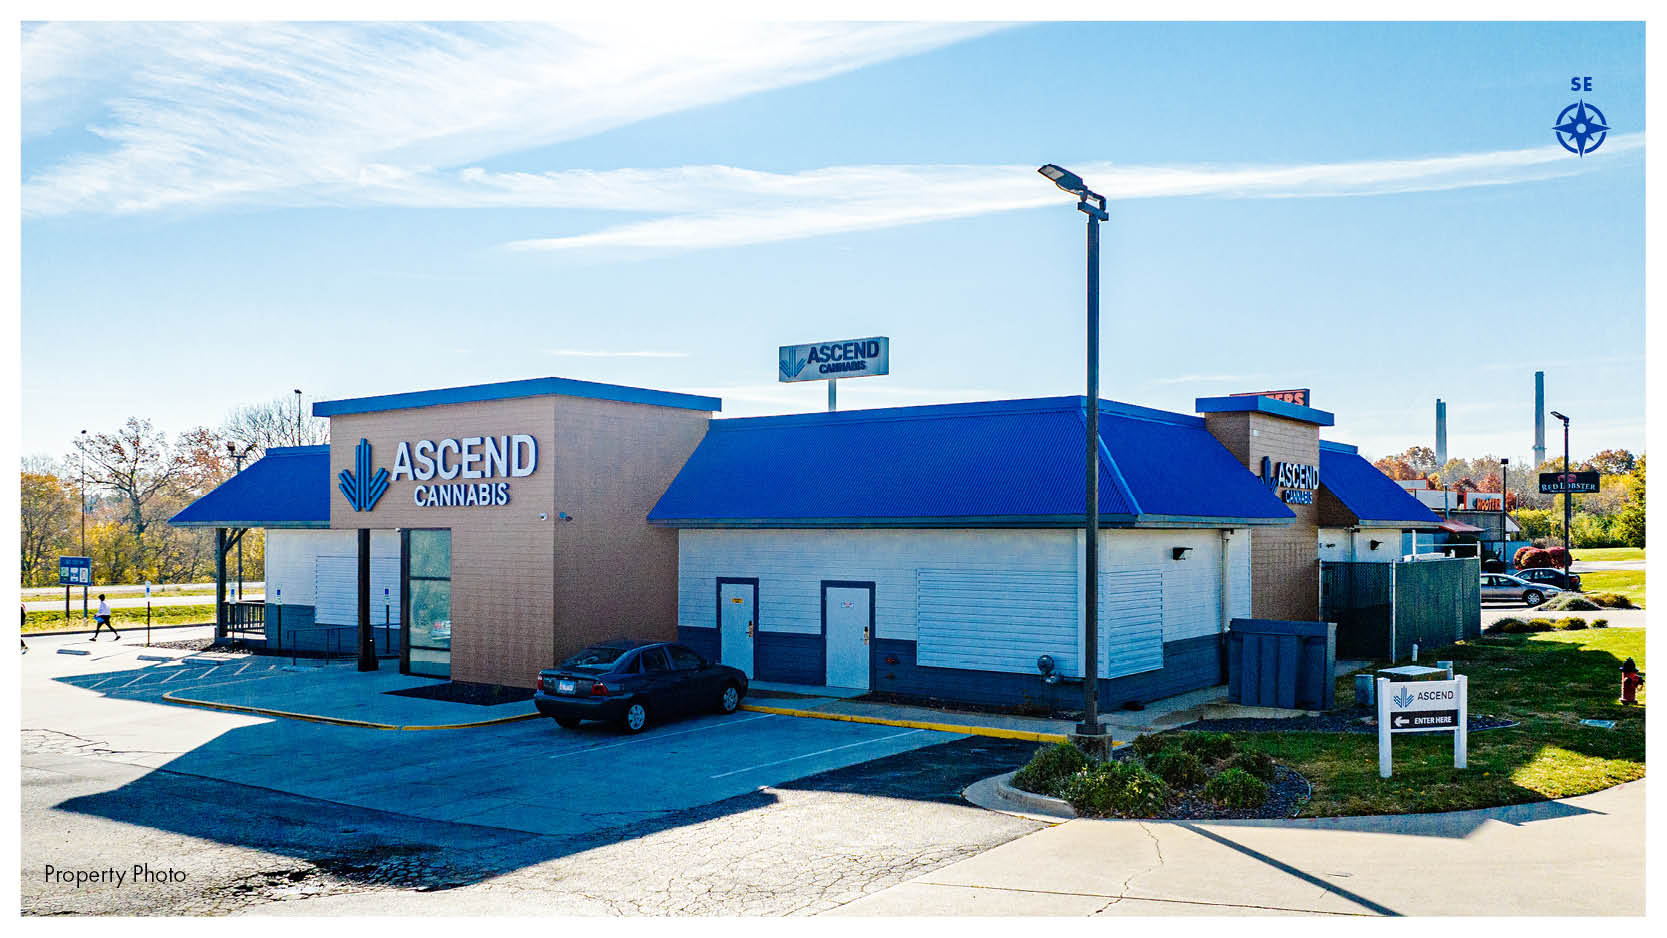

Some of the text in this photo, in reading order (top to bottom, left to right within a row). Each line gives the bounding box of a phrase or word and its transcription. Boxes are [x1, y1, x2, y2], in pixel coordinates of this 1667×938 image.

[807, 341, 879, 364] ASCEND
[819, 361, 866, 374] CANNABIS
[392, 434, 538, 481] ASCEND
[1278, 462, 1319, 490] ASCEND
[1541, 483, 1559, 491] RED
[414, 482, 510, 507] CANNABIS
[1284, 490, 1312, 504] CANNABIS
[1417, 691, 1454, 700] ASCEND
[1414, 716, 1452, 725] ENTER HERE
